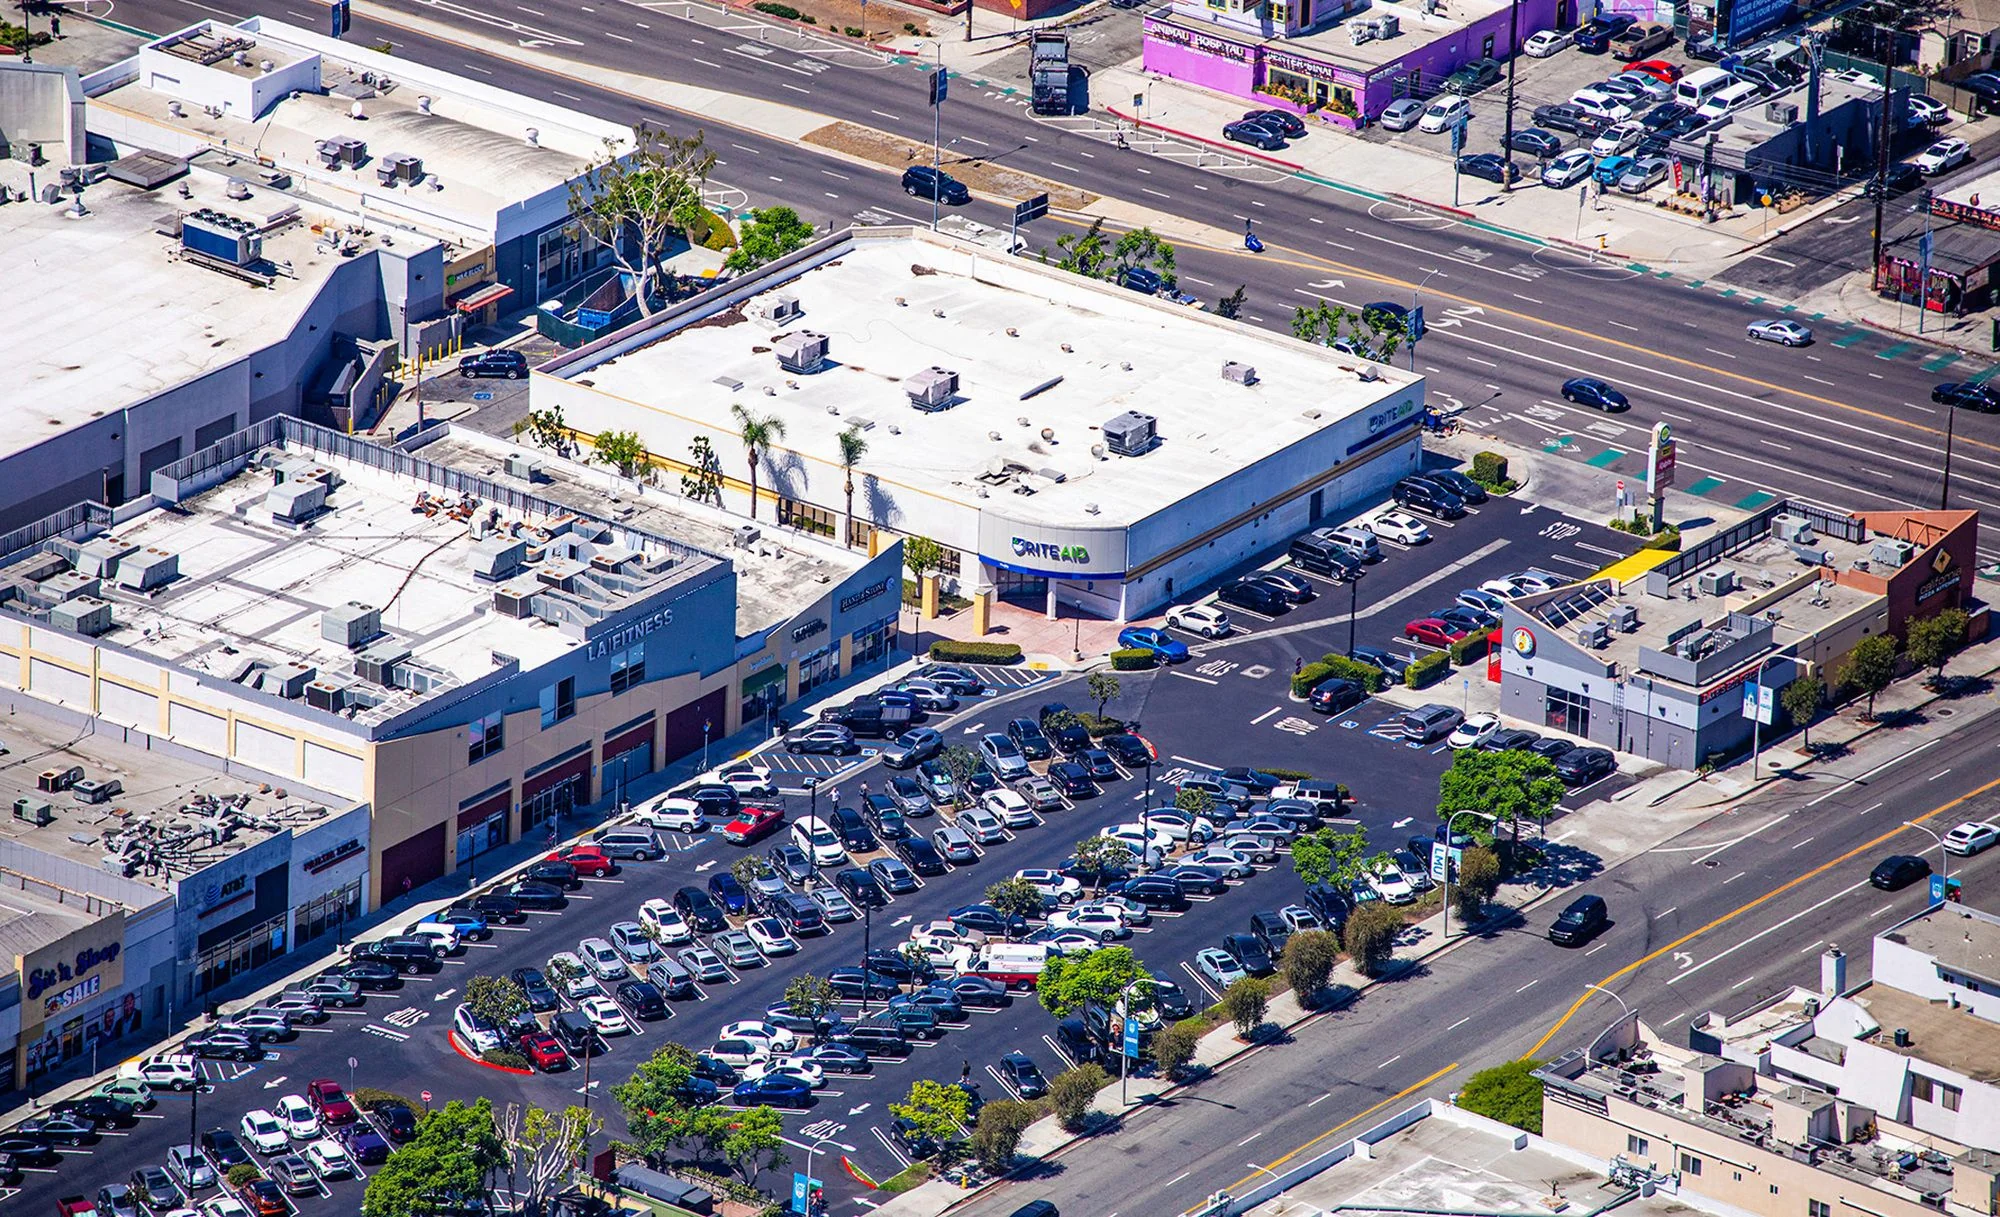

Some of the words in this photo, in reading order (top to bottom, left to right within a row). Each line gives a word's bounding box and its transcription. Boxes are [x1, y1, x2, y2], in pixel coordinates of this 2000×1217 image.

[1538, 521, 1581, 540] STOP
[1025, 541, 1060, 561] RITE
[1061, 545, 1089, 564] AID
[612, 608, 673, 652] FITNESS
[1195, 659, 1240, 677] STOP
[1273, 716, 1319, 736] STOP
[1433, 847, 1444, 876] LMU
[75, 942, 121, 977] Sleep
[62, 975, 99, 1009] SALE
[383, 1006, 430, 1029] STOP
[799, 1119, 847, 1140] STOP
